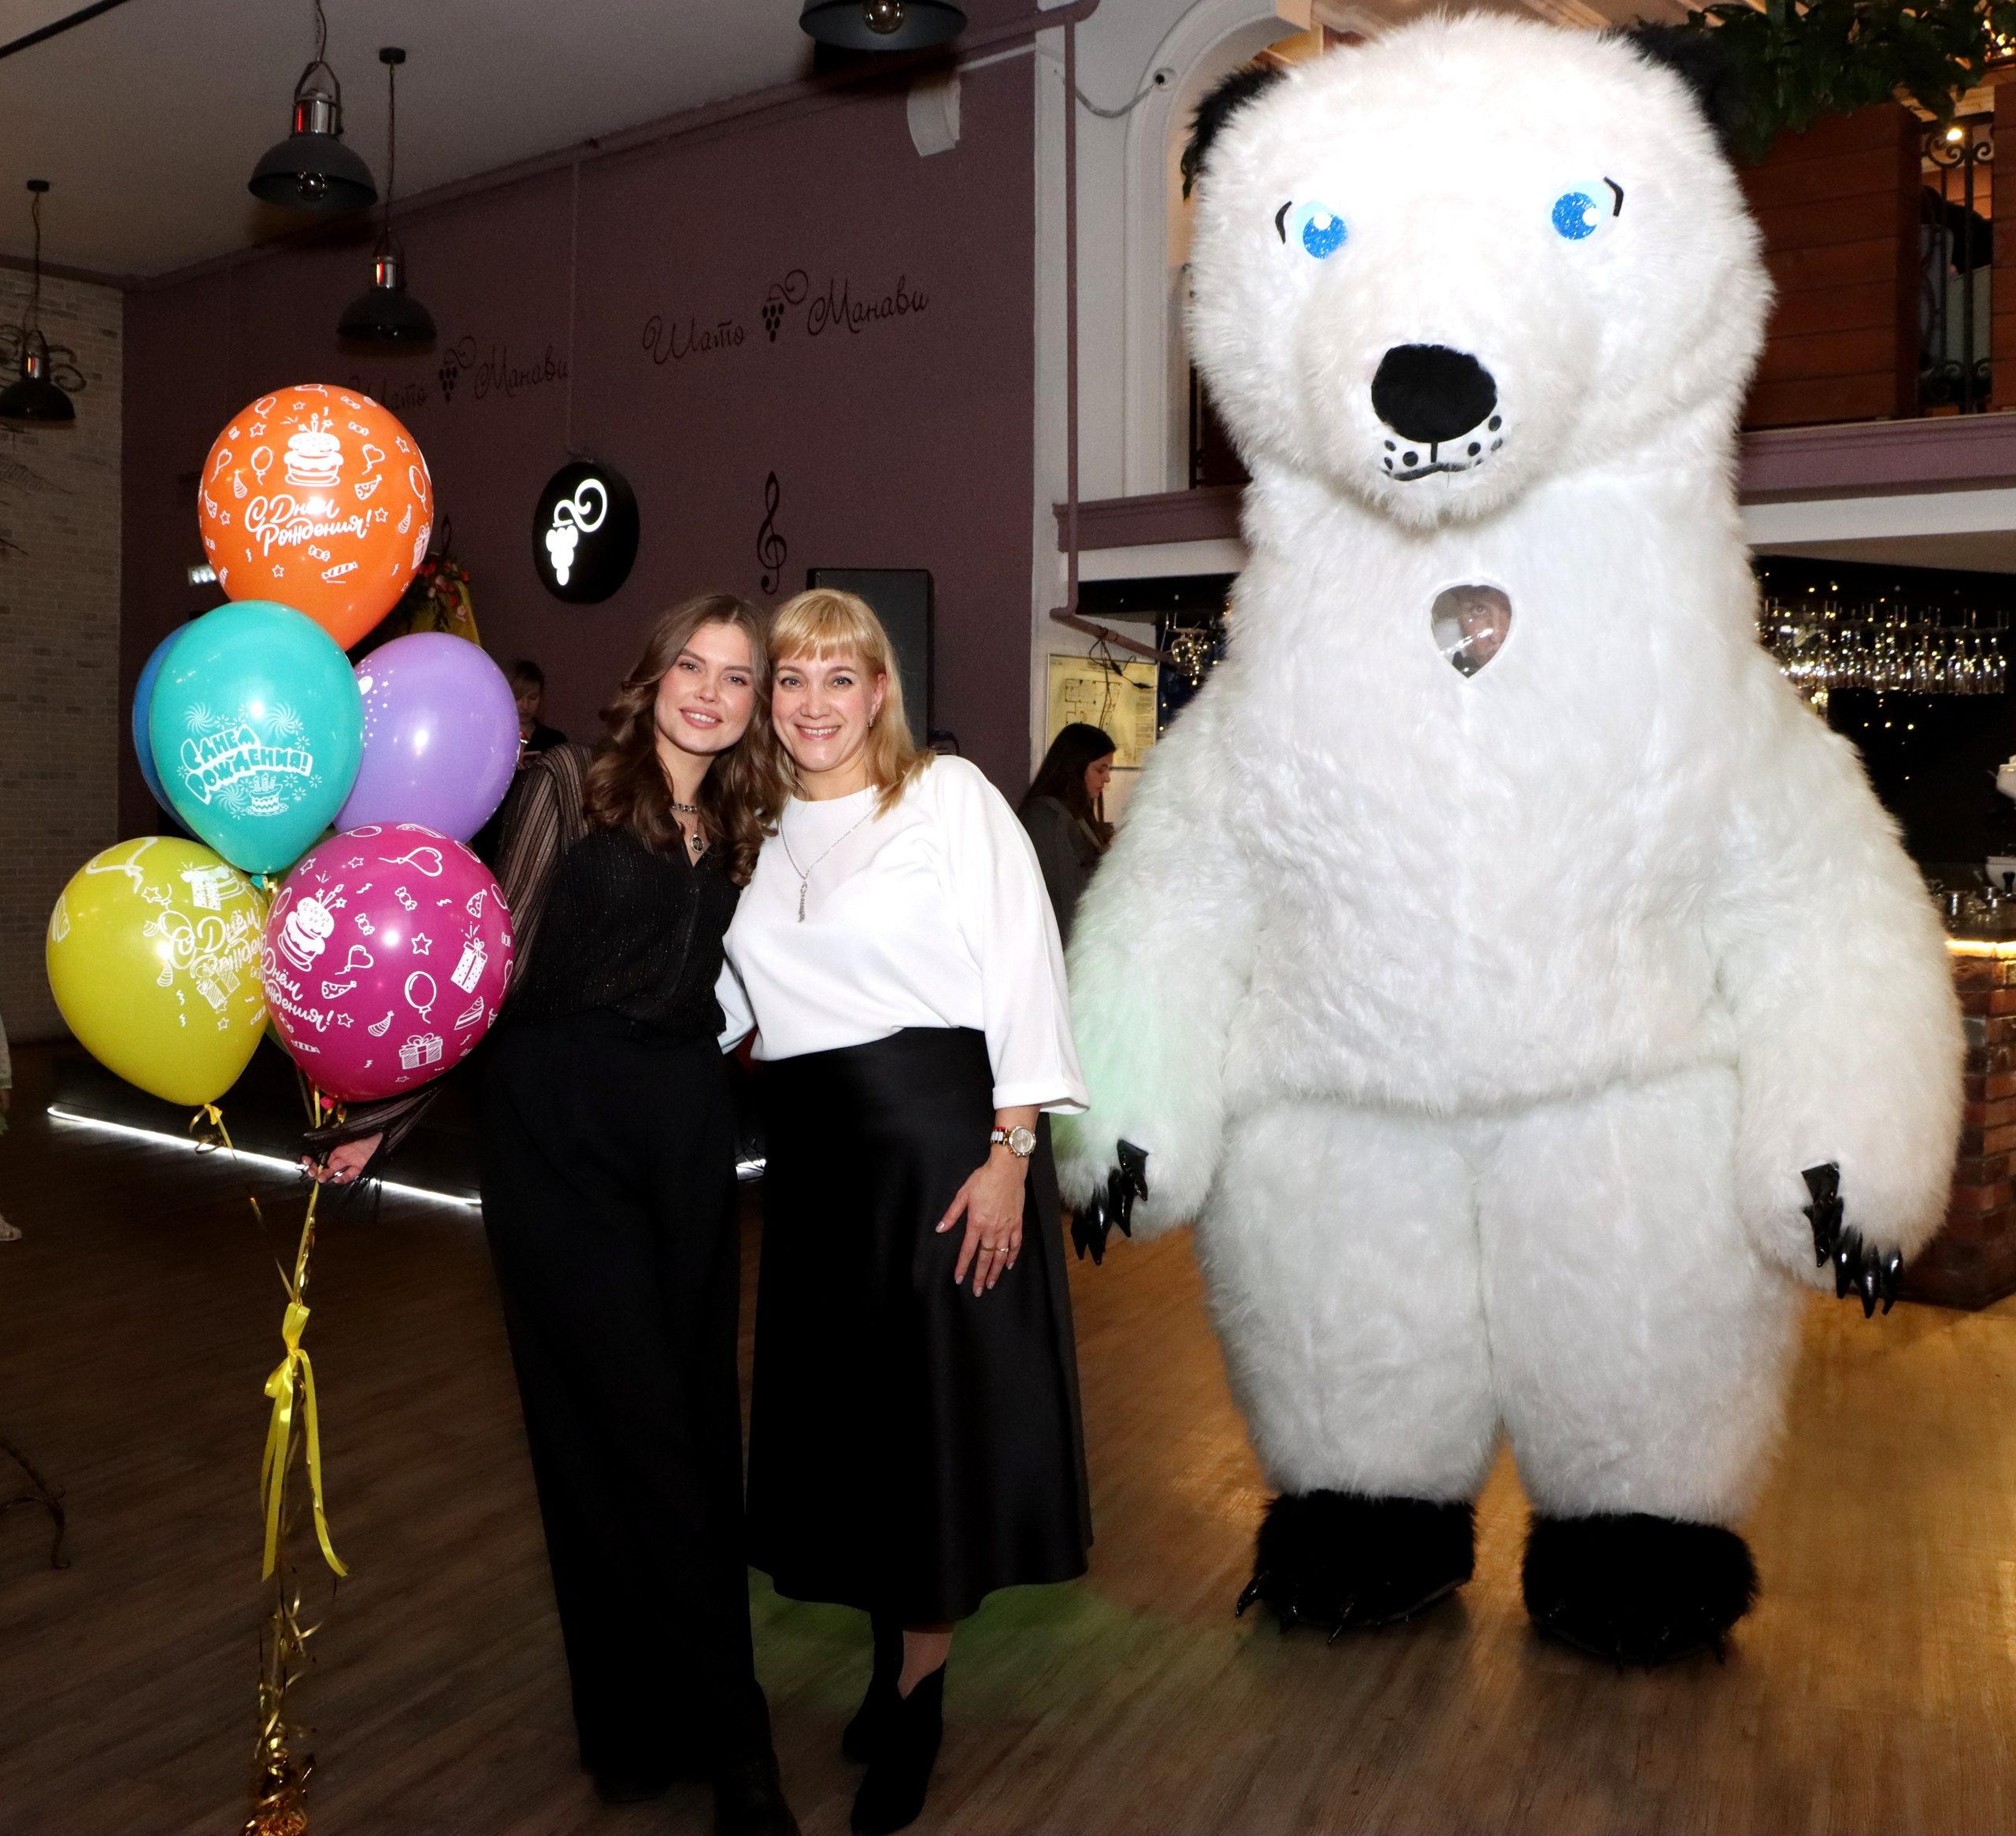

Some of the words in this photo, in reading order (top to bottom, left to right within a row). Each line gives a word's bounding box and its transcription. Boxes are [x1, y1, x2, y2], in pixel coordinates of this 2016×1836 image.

[642, 315, 745, 365] Шато
[806, 275, 929, 336] Манави
[474, 344, 569, 400] Манави
[244, 495, 269, 532] С
[256, 509, 372, 557] Рождения!
